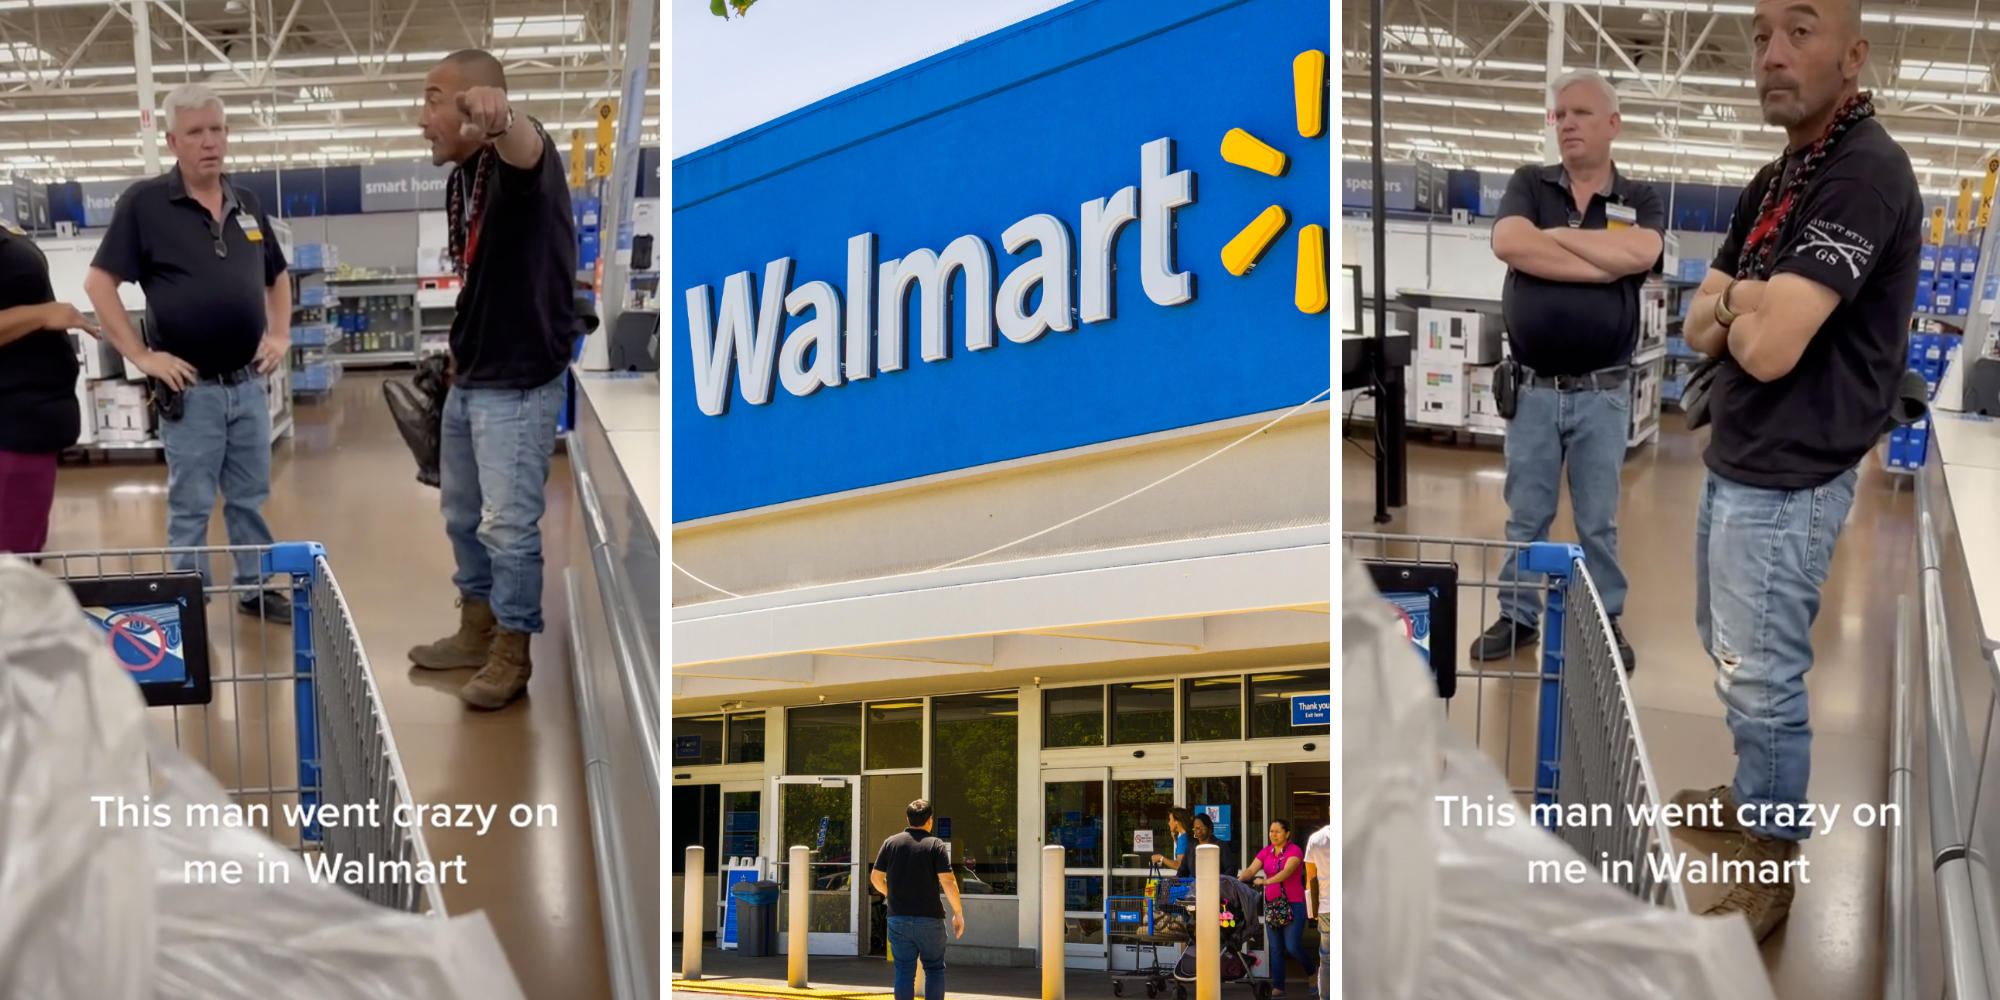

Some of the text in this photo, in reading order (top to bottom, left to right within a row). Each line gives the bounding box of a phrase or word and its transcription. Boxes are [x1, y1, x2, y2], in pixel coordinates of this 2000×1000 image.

[365, 176, 447, 195] smart hom
[1345, 176, 1402, 193] speaers
[1815, 248, 1840, 266] GS
[685, 137, 1198, 416] Walmart
[1298, 701, 1330, 711] Thank you
